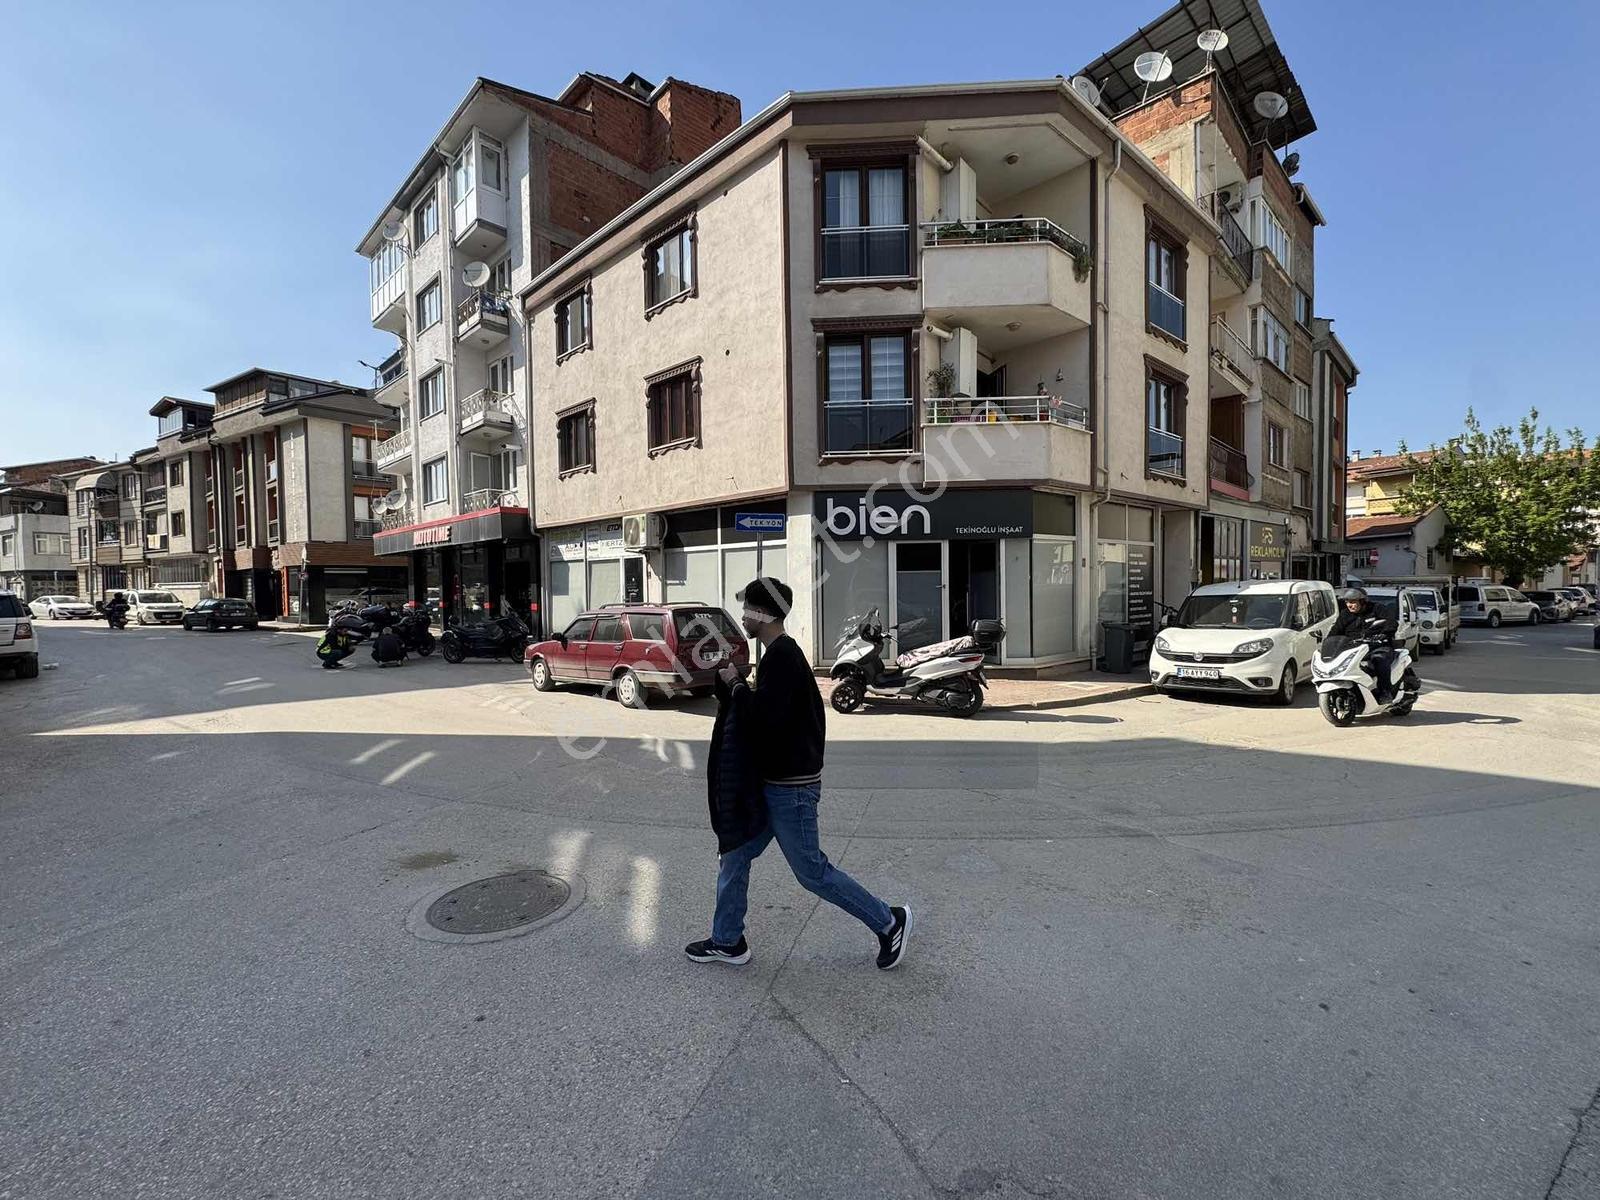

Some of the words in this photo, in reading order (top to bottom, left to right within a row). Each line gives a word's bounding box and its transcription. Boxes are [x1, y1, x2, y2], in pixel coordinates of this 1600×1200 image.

[826, 497, 931, 536] bien
[413, 525, 451, 546] MOTOTIME
[955, 526, 997, 534] TEKİNOĞLU
[997, 525, 1024, 535] İNŞAAT
